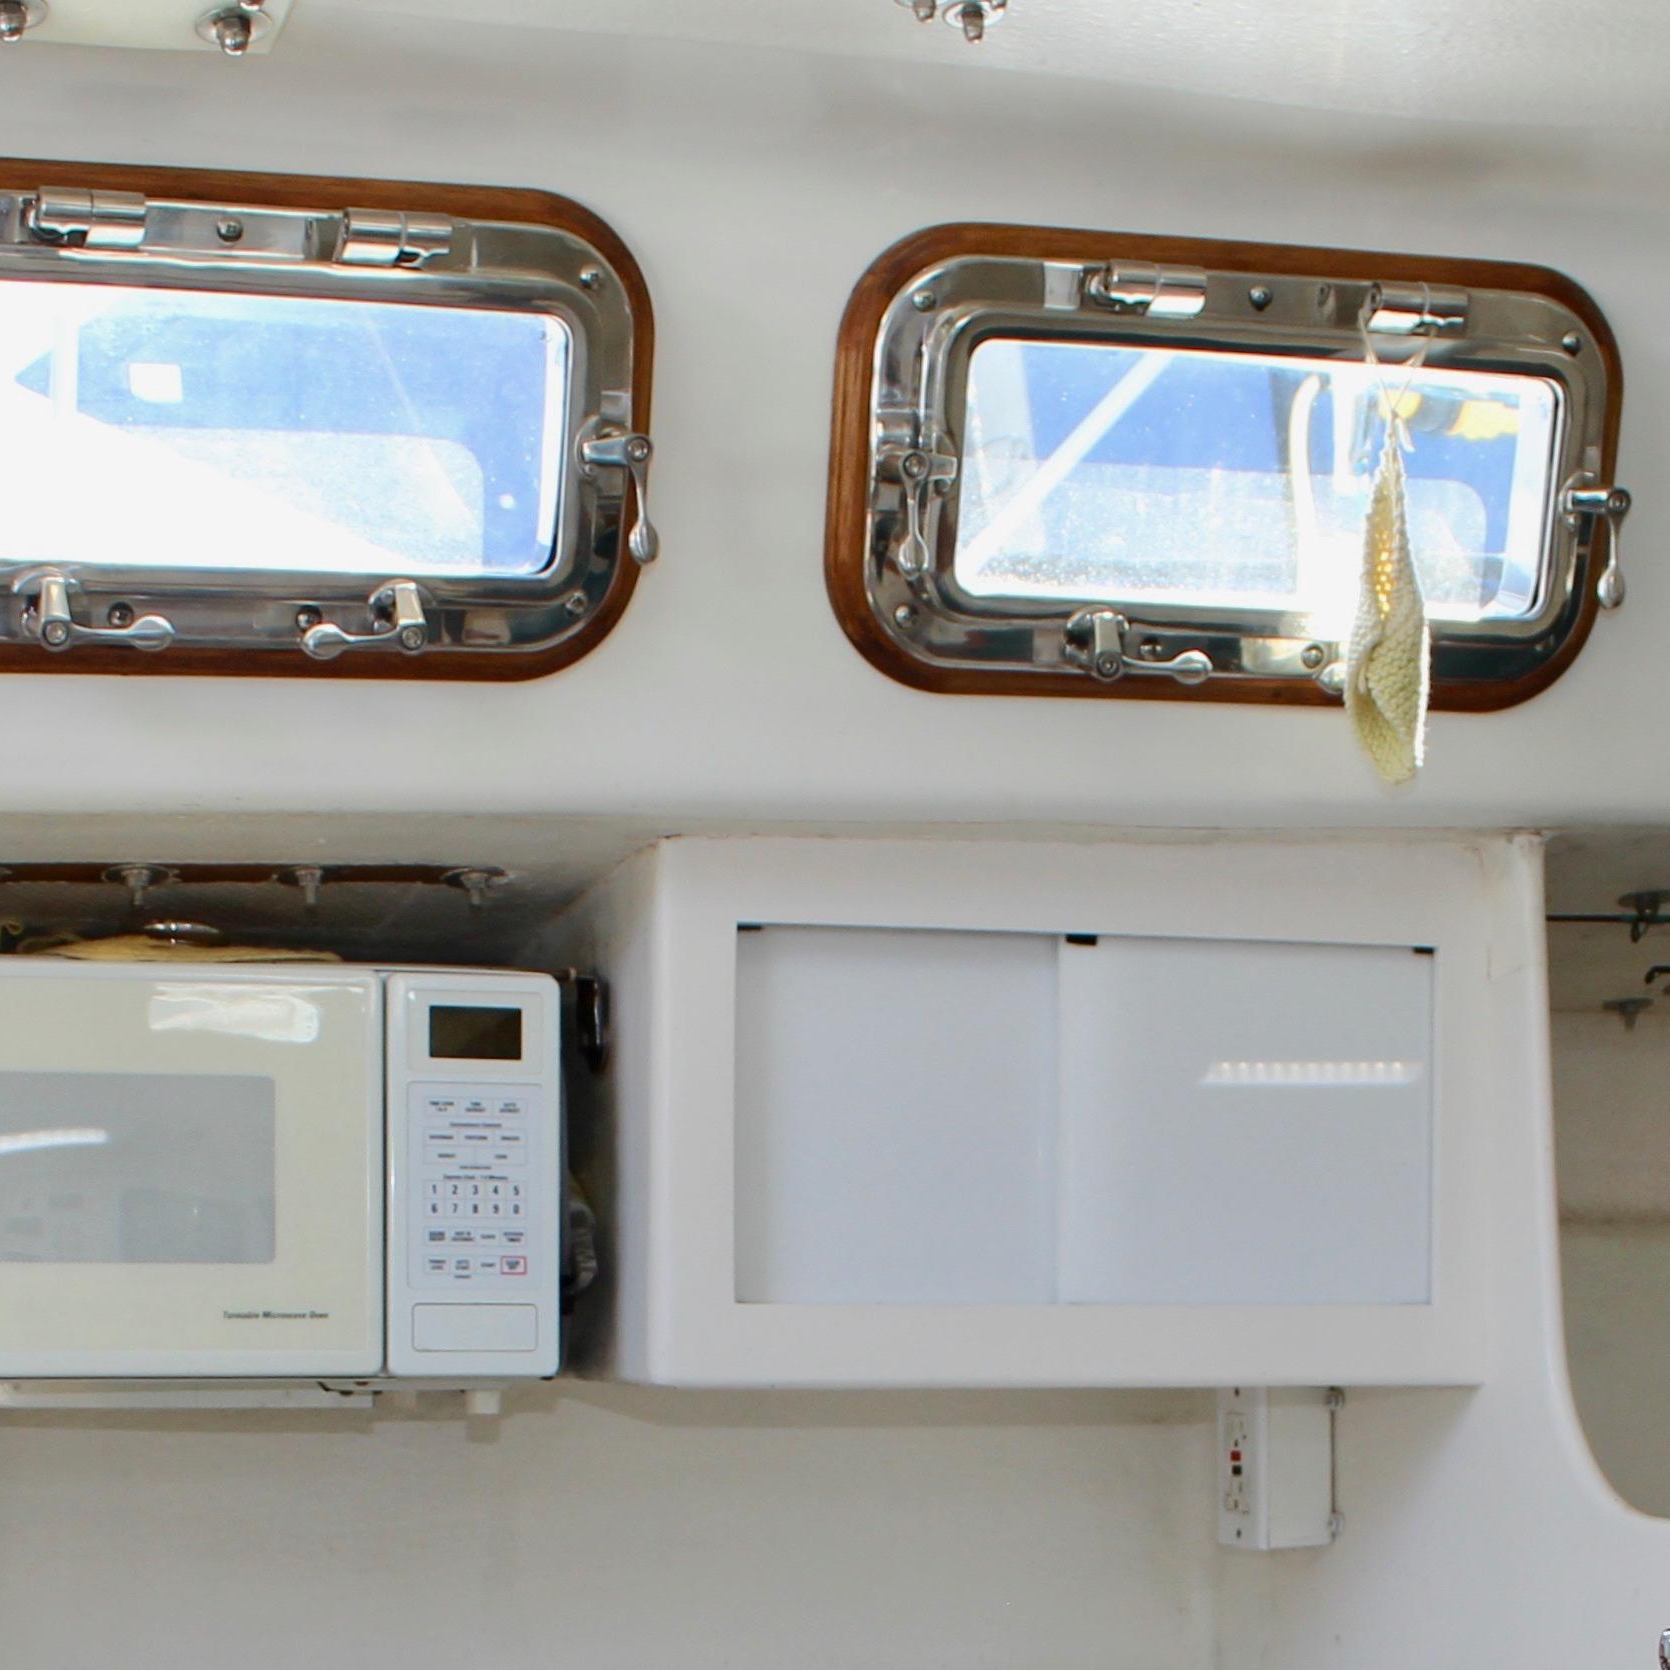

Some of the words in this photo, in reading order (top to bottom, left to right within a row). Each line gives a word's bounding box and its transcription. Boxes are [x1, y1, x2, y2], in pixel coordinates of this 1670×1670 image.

[431, 1184, 437, 1196] 1
[452, 1184, 458, 1196] 2
[473, 1184, 479, 1196] 3
[492, 1184, 499, 1196] 4
[513, 1184, 520, 1196] 5
[431, 1203, 437, 1214] 6
[452, 1203, 458, 1214] 7
[473, 1203, 479, 1214] 8
[492, 1203, 499, 1214] 9
[513, 1203, 520, 1214] 0
